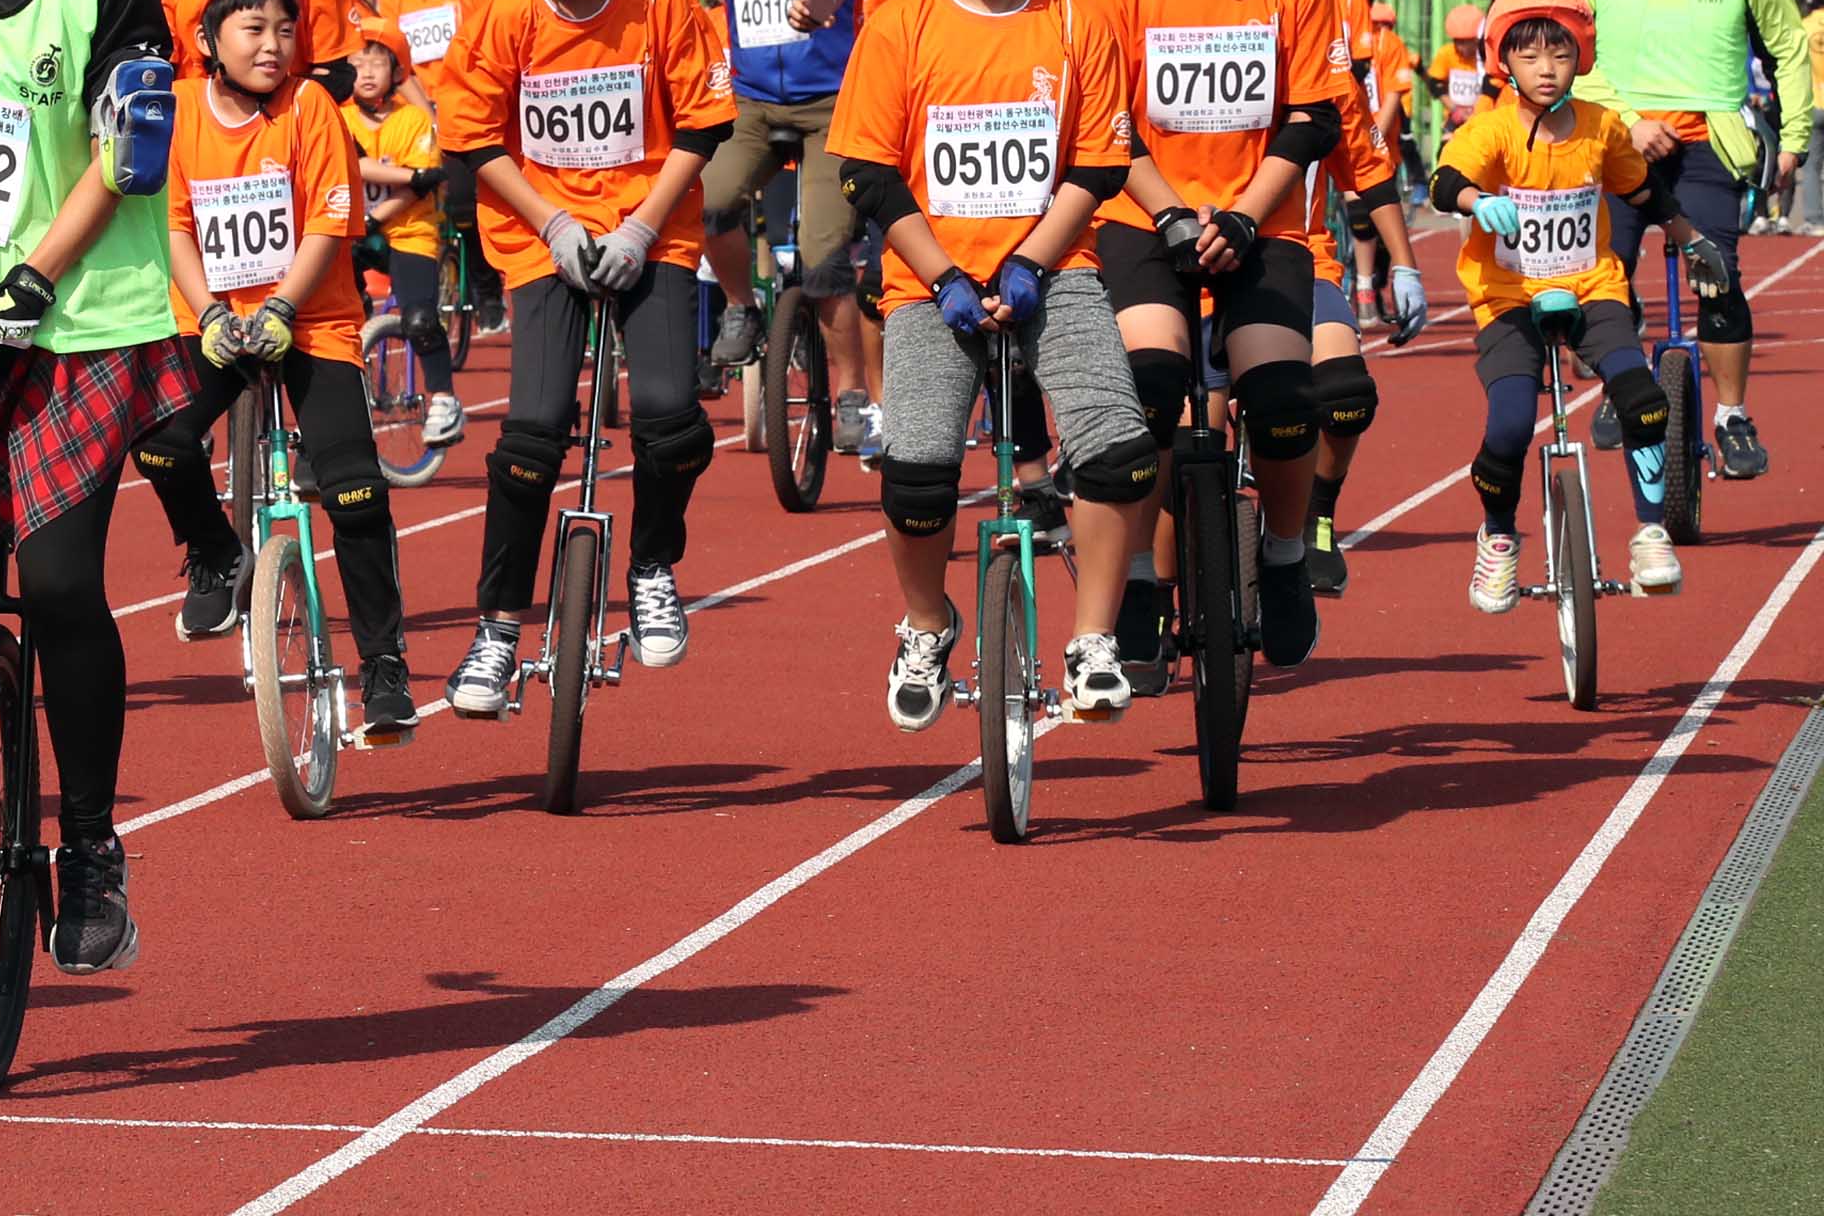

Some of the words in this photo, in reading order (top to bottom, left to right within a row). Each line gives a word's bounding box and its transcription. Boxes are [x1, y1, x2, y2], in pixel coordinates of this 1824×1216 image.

[19, 85, 64, 107] STAFF
[1156, 60, 1266, 105] 07102
[525, 98, 635, 142] 06104
[933, 138, 1050, 186] 05105
[196, 207, 289, 259] 4105
[1503, 212, 1591, 253] 03103
